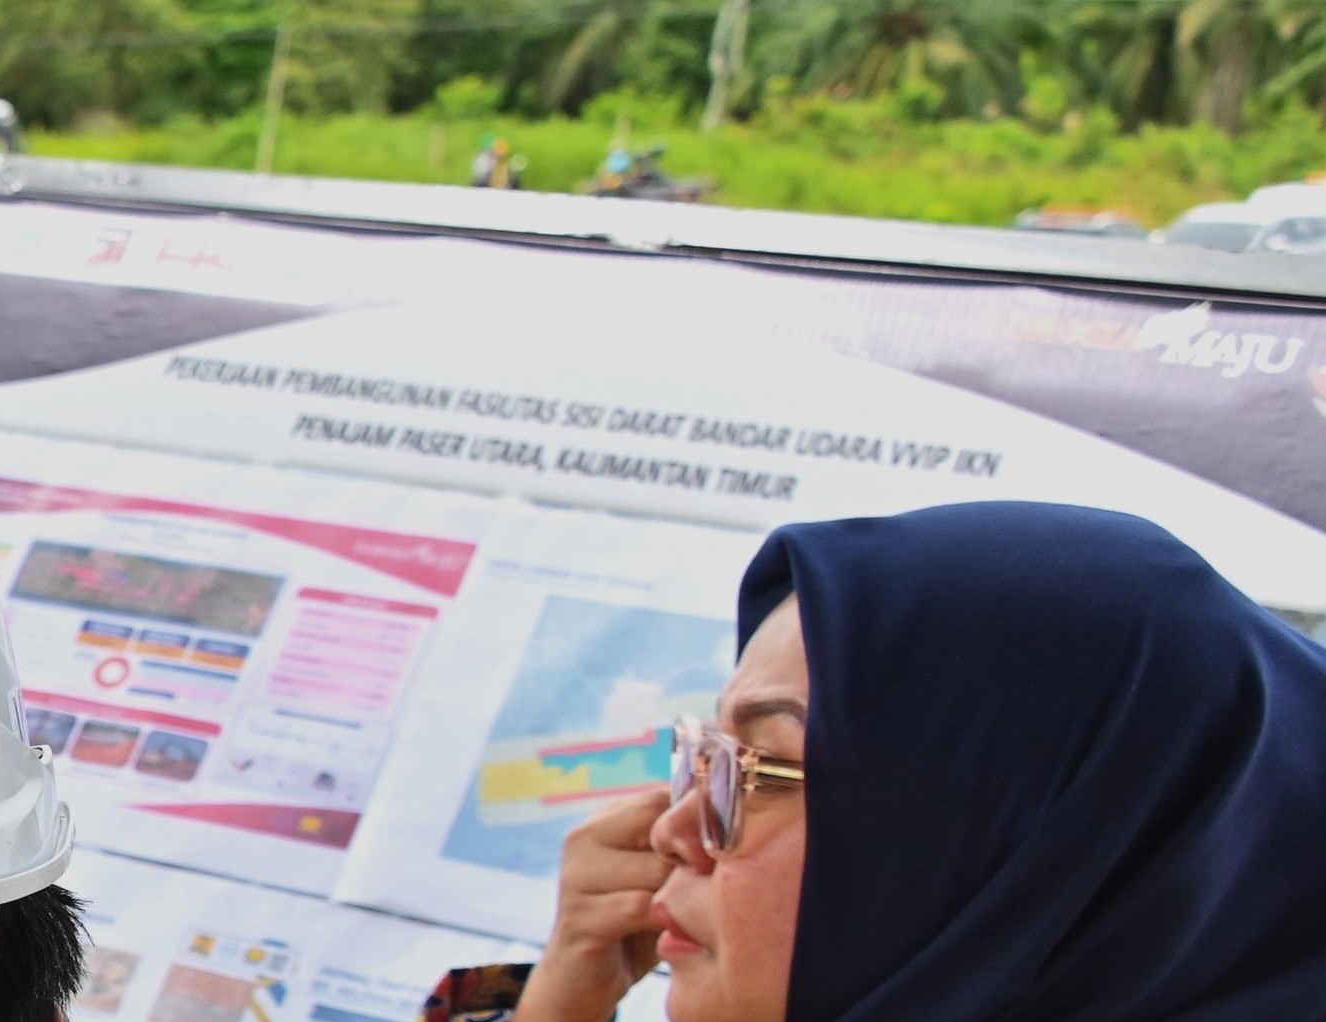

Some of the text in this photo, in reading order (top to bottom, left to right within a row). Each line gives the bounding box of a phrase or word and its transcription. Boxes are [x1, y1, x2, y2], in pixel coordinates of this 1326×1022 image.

[1159, 329, 1305, 378] MAJU
[165, 356, 1001, 477] PEKERJAAN PEMBANGUNAN FASILITAS SISI DARAT BANDAR UDARA VVIP IKN
[292, 413, 797, 500] PENAJAM PASER UTARA, KALIMANTAN TIMUR
